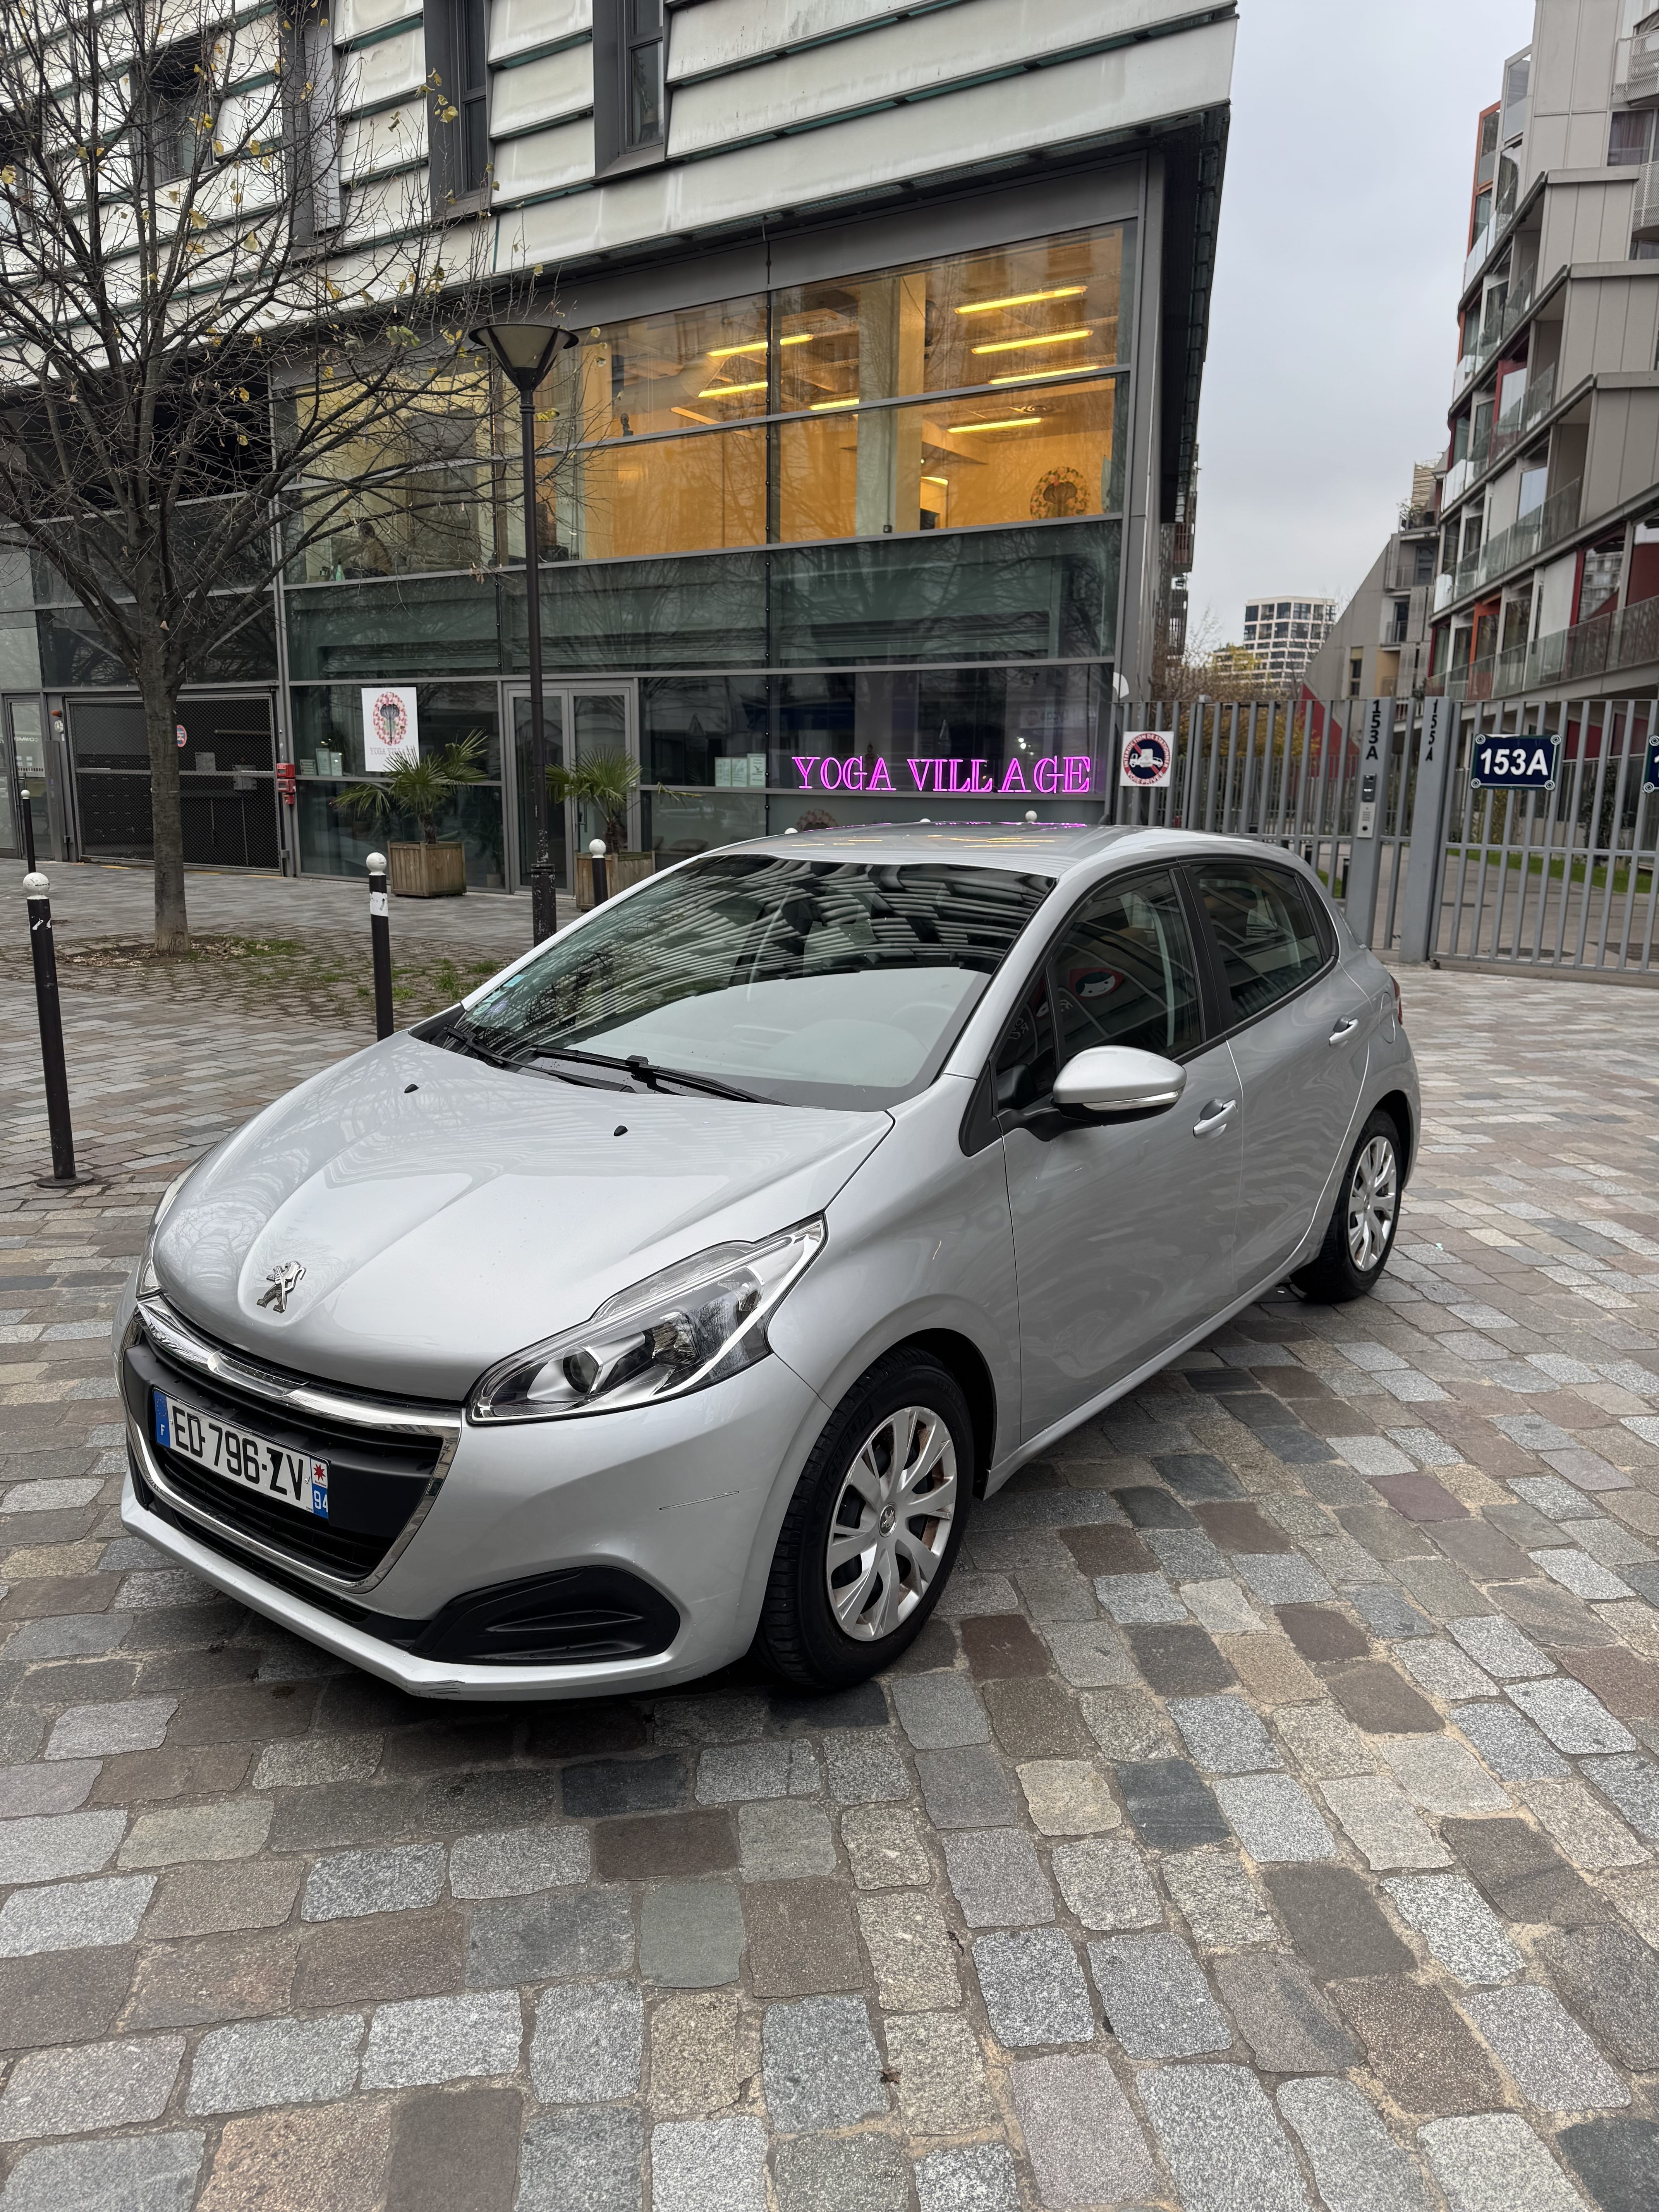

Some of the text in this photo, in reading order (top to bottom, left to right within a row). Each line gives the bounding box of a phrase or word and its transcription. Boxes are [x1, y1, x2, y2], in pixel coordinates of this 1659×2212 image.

[1365, 699, 1381, 761] 153A
[1425, 699, 1439, 761] 155A
[791, 756, 897, 791] YOGA
[907, 755, 1092, 794] VILLAGE
[1480, 748, 1548, 776] 153A
[161, 1405, 303, 1501] F ED-796-ZV
[314, 1490, 328, 1513] 94
